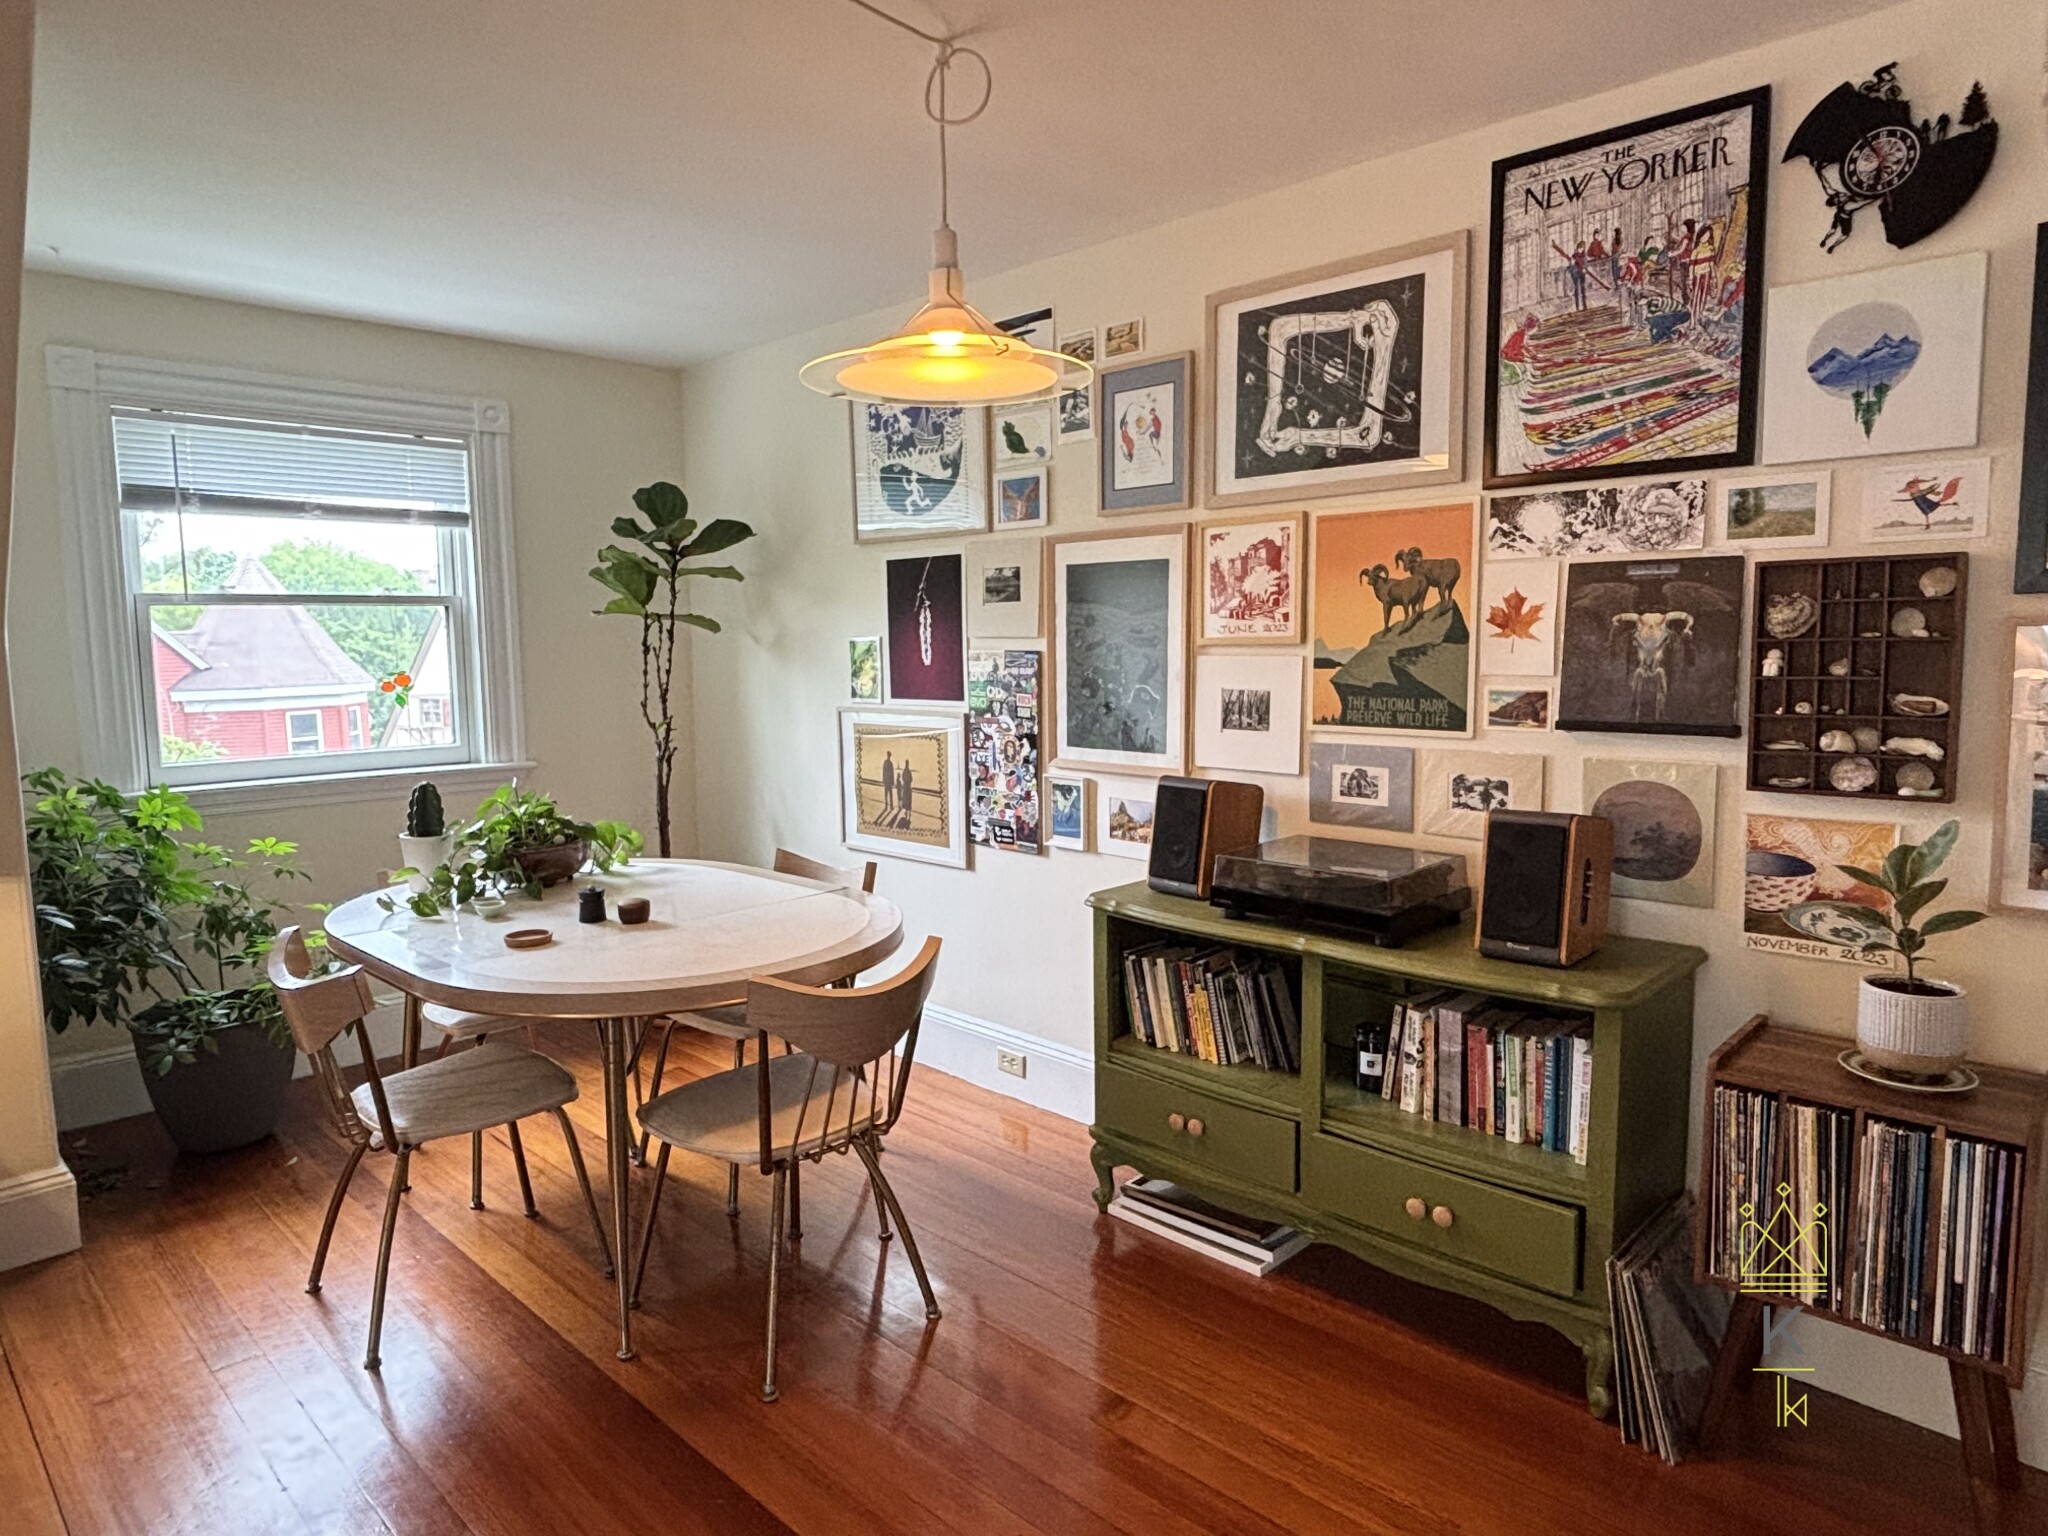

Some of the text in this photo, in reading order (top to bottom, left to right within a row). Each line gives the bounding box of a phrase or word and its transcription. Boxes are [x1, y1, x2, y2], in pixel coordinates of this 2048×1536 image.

[1601, 144, 1636, 163] THE
[1525, 136, 1734, 215] NEW YORKER
[1217, 623, 1289, 635] JUNE 2023
[1347, 695, 1449, 714] THE NATIONAL PARKS
[1346, 709, 1449, 728] PRESERVE WILD LIFE
[1746, 935, 1888, 966] NOVEMBER 2023
